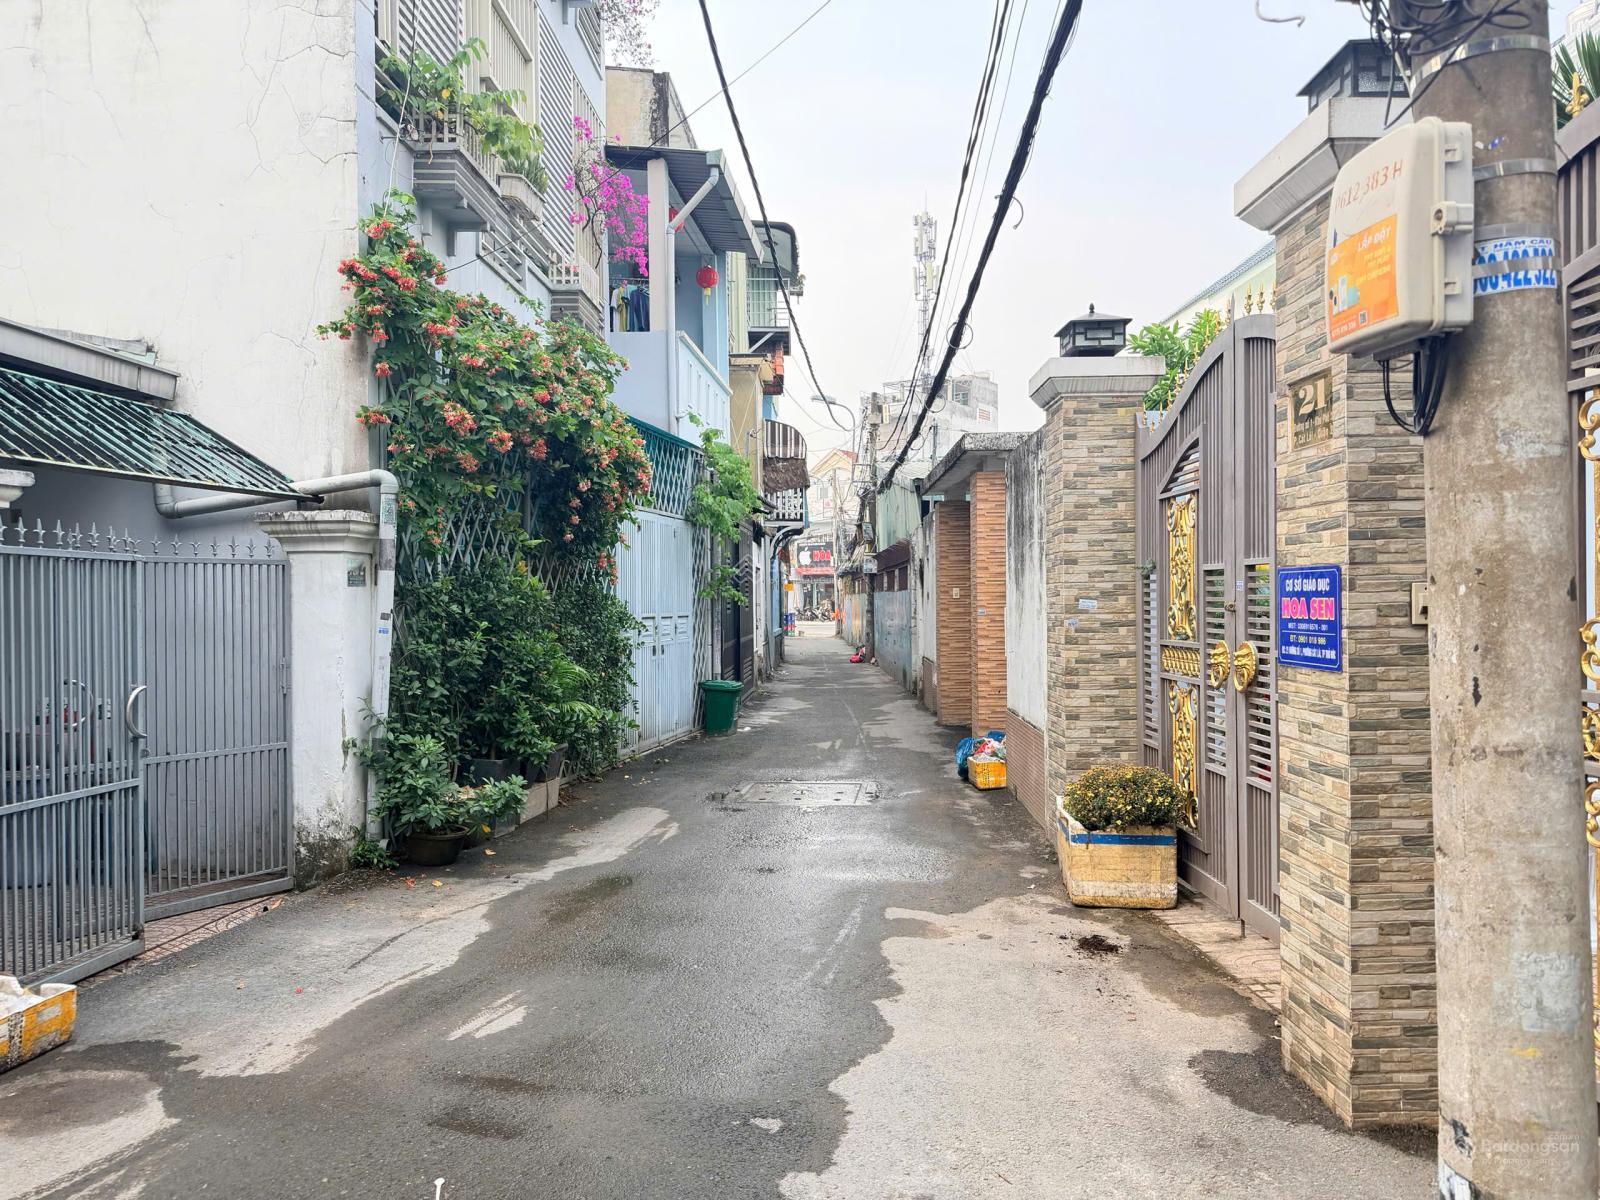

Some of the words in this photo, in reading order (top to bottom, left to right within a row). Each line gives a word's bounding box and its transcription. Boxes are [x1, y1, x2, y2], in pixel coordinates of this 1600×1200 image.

[1299, 378, 1327, 411] 21
[1302, 576, 1316, 591] GIÁO
[1317, 578, 1330, 594] DỤC
[1281, 597, 1308, 619] HOA
[1310, 597, 1335, 620] SEN
